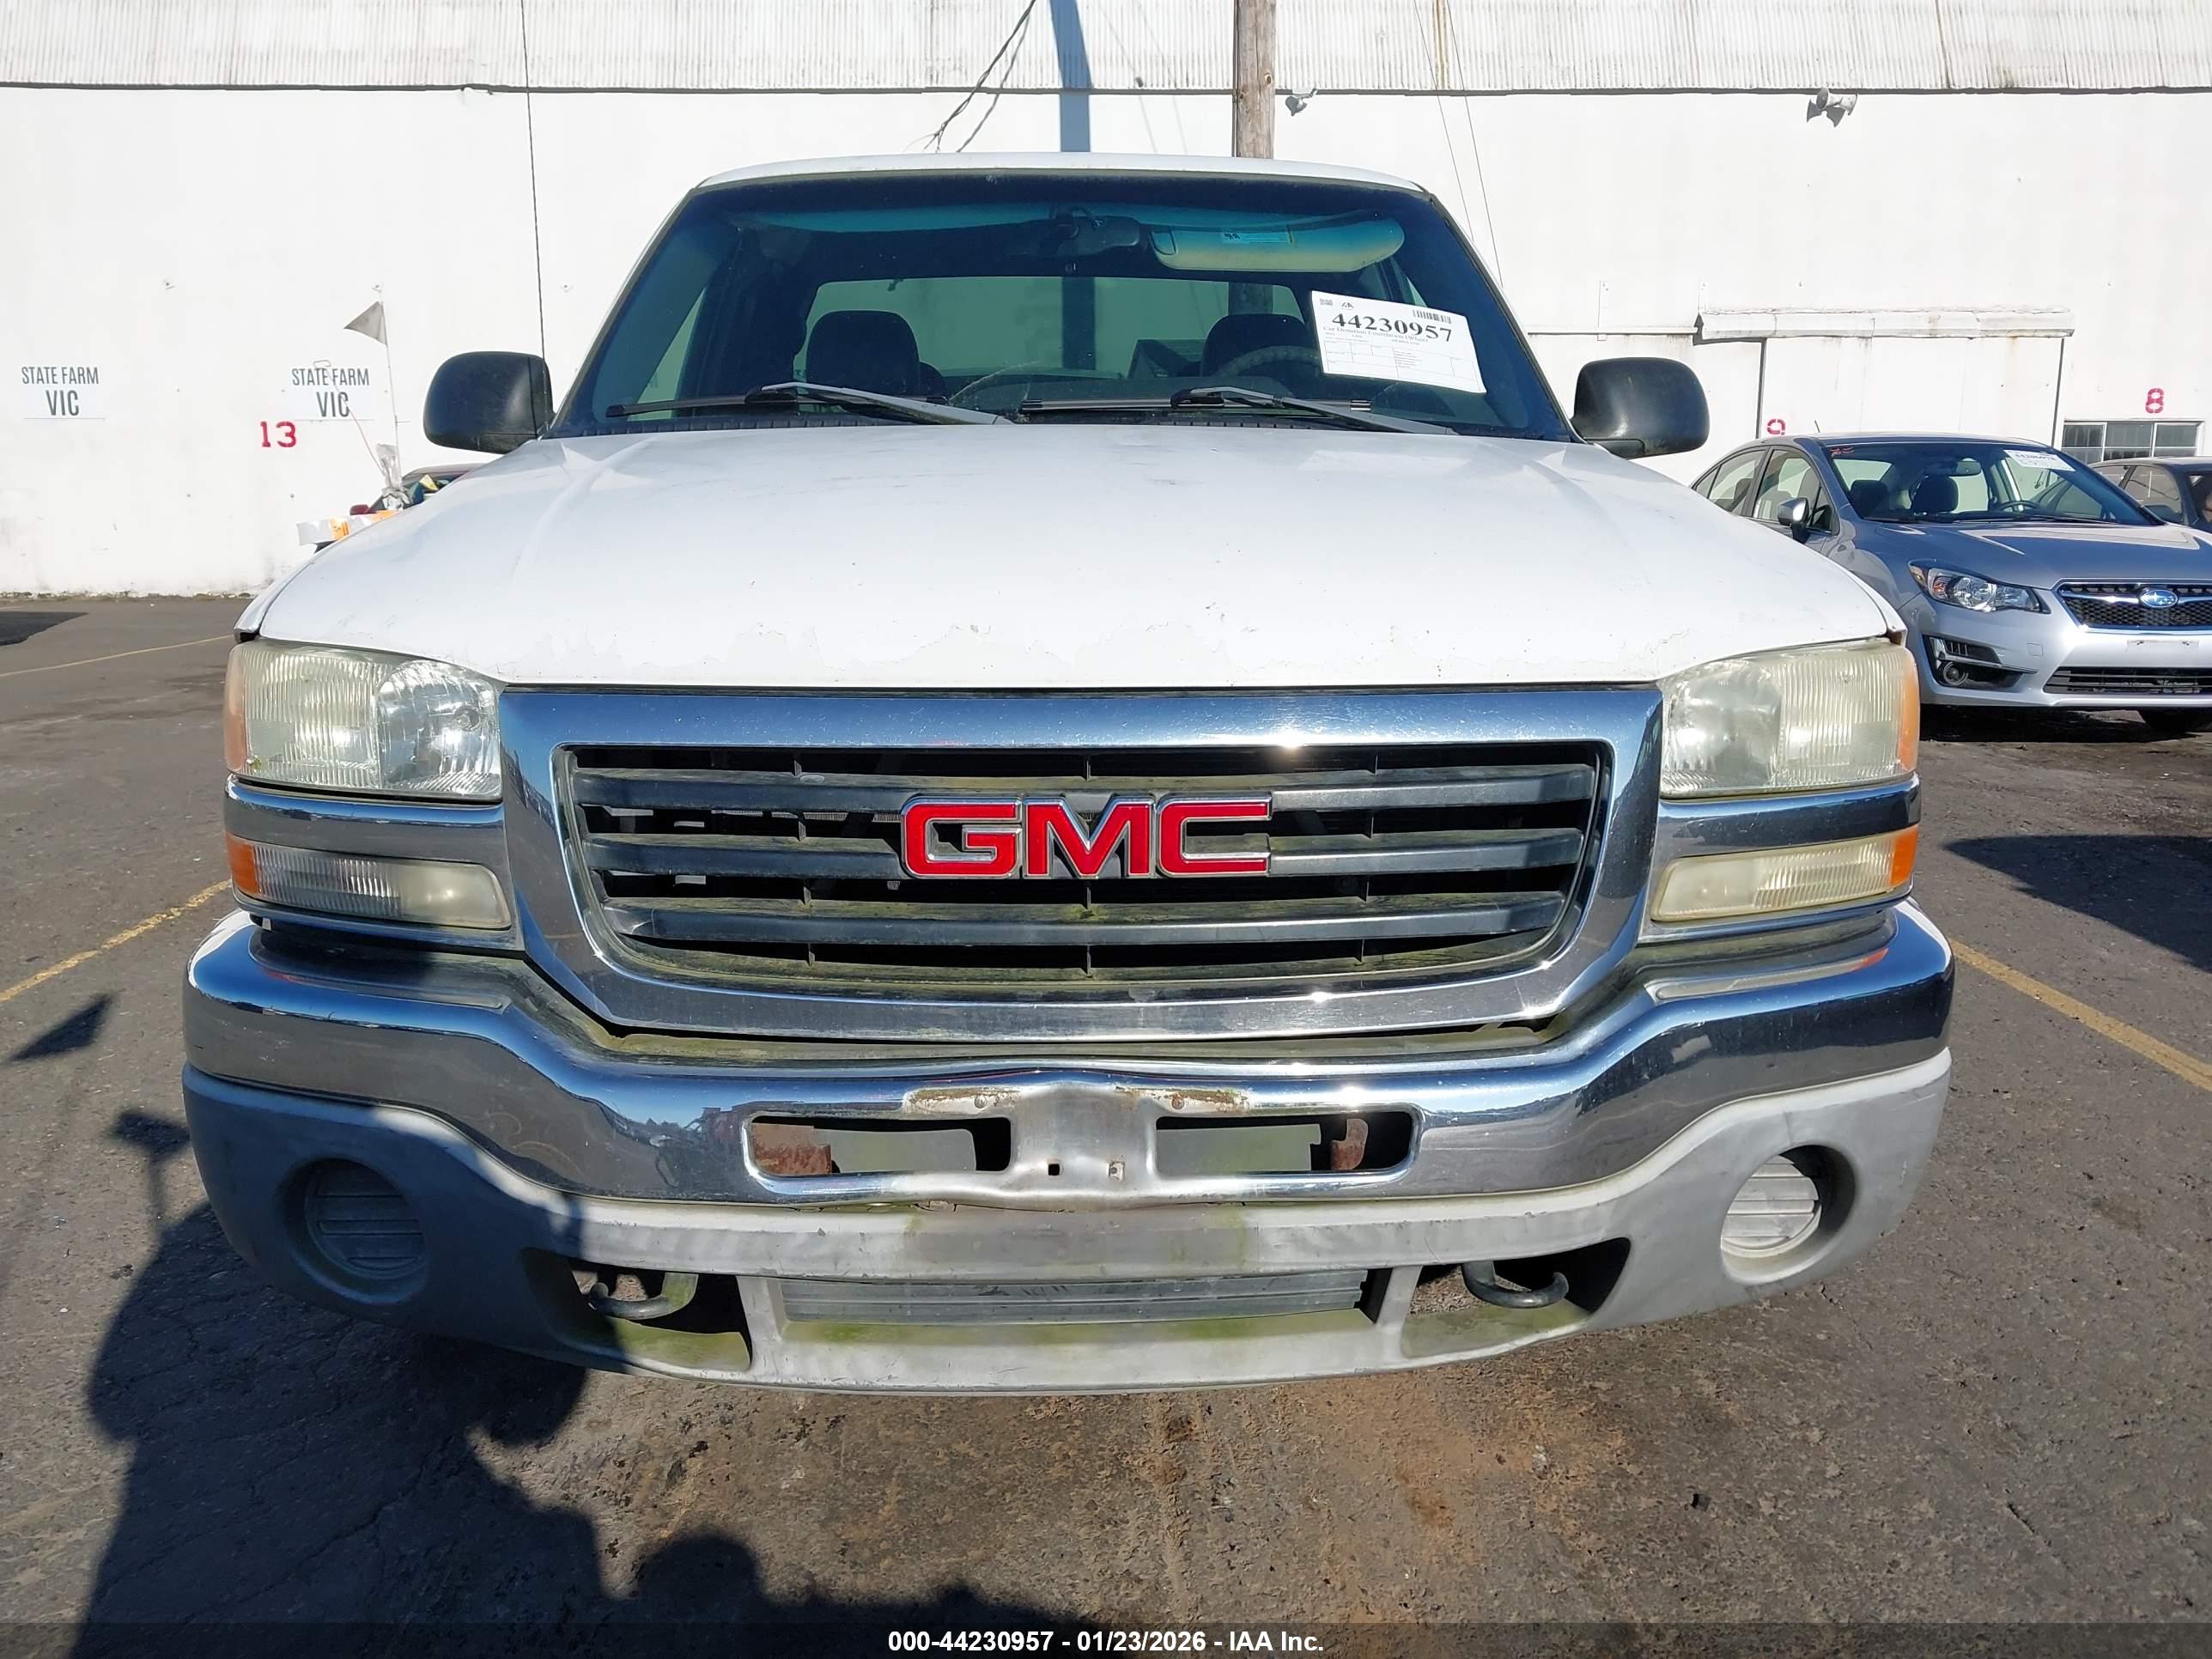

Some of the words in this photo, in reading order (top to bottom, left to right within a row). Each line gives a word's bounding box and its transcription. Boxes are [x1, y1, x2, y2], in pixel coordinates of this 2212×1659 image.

[1332, 313, 1452, 342] 44230957
[21, 366, 58, 385] STATE
[61, 366, 99, 385] FARM
[292, 368, 328, 386] STATE
[332, 368, 369, 386] FARM
[46, 390, 79, 416] VIC
[316, 392, 350, 417] VIC
[2145, 388, 2164, 414] 8
[259, 421, 297, 448] 13
[902, 797, 1273, 878] GMC
